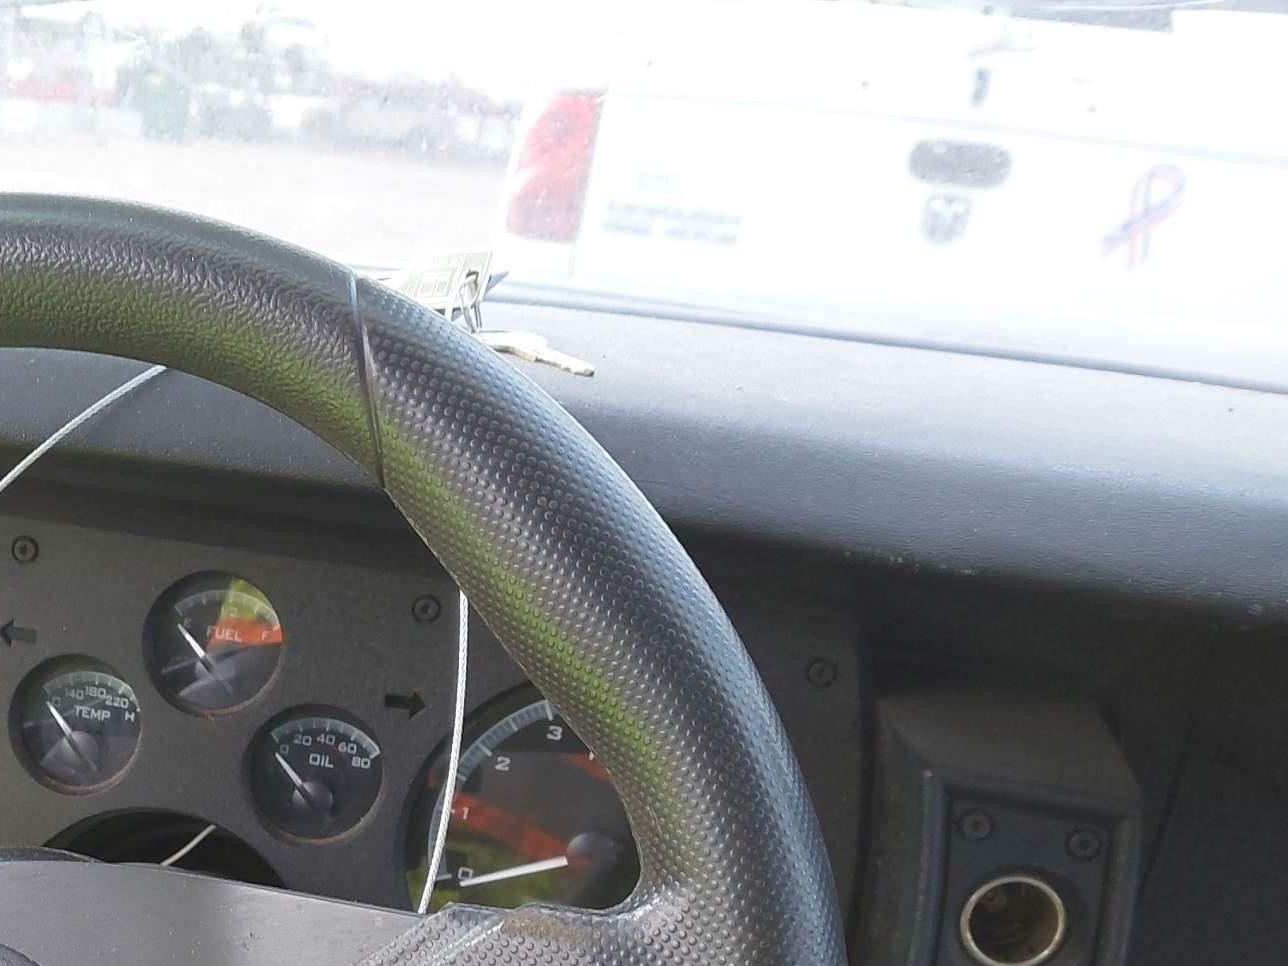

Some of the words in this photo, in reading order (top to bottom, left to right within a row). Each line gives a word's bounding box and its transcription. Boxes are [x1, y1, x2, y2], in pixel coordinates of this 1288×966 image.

[206, 624, 242, 643] FUEL
[262, 630, 271, 641] F
[65, 688, 84, 700] 140
[86, 686, 106, 699] 180
[105, 695, 129, 708] 220
[74, 705, 111, 720] TEMP
[125, 711, 135, 722] H
[316, 734, 336, 745] 40
[546, 725, 562, 741] 3
[294, 734, 312, 746] 20
[280, 744, 289, 755] 0
[338, 742, 357, 754] 60
[309, 753, 334, 768] OIL
[352, 756, 371, 769] 80
[495, 756, 510, 771] 2
[462, 807, 469, 820] 1
